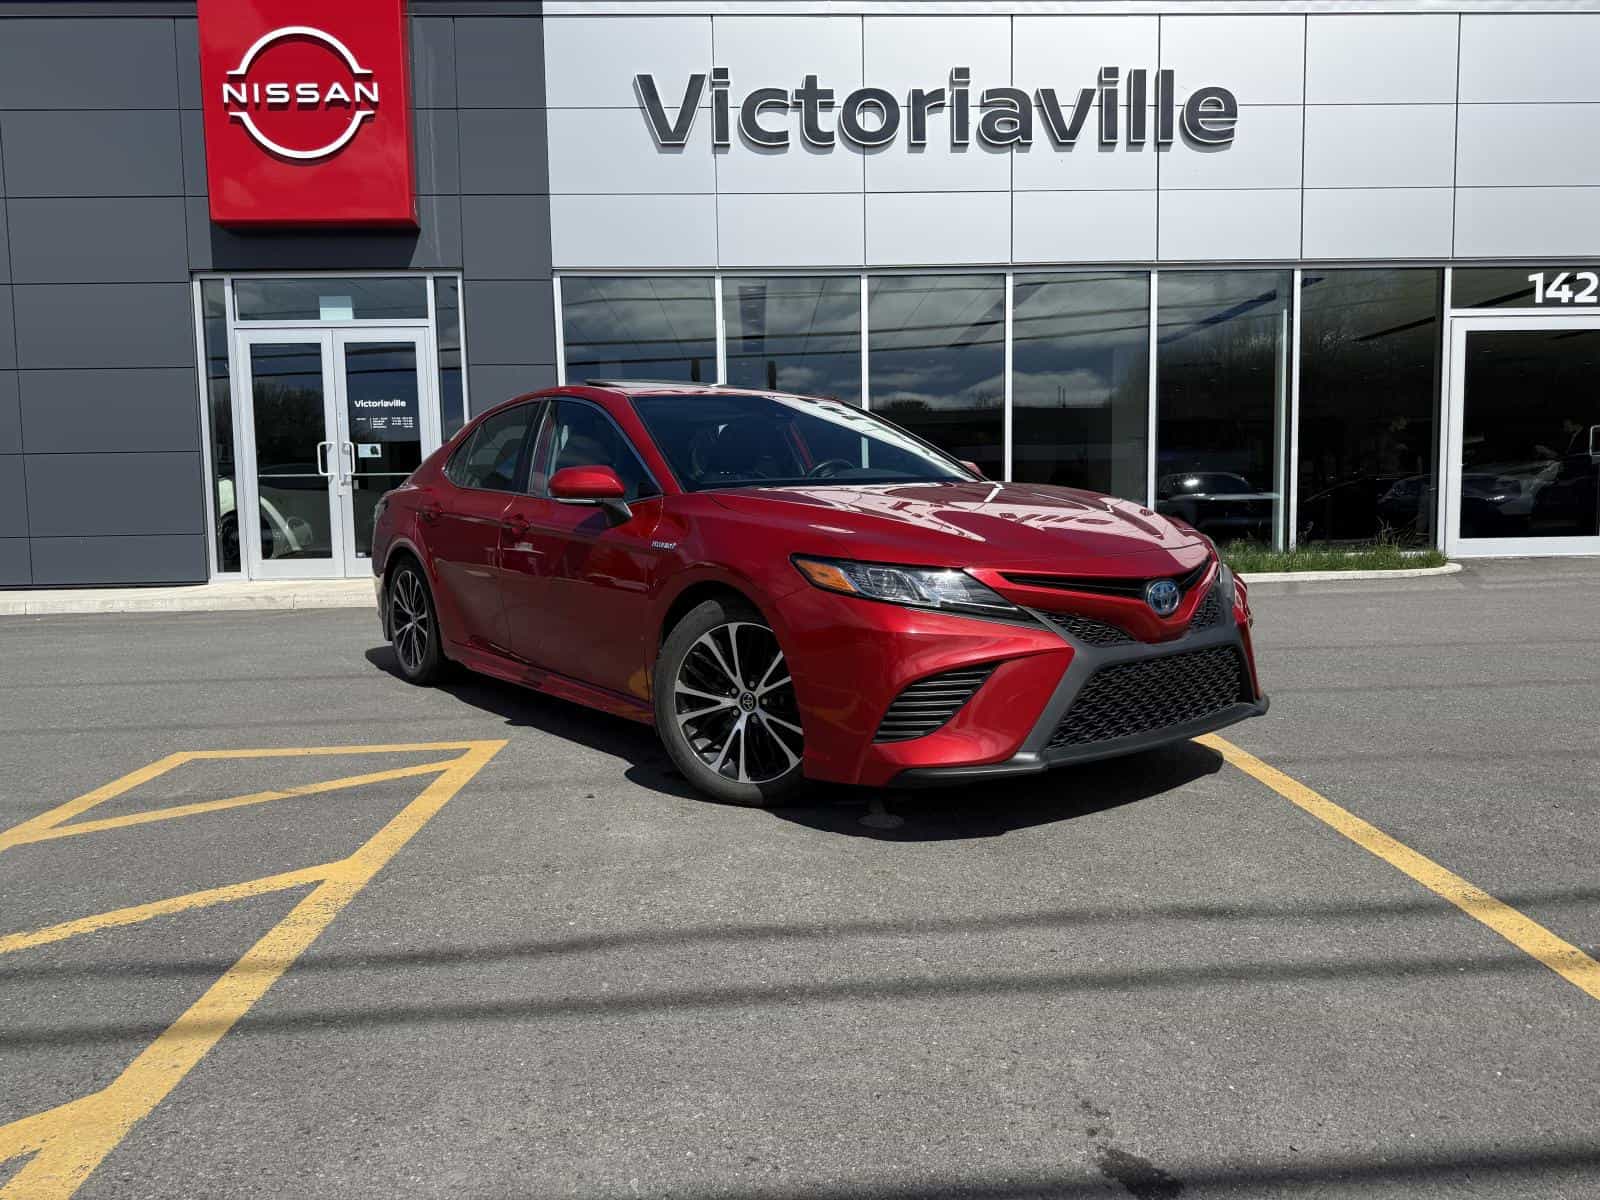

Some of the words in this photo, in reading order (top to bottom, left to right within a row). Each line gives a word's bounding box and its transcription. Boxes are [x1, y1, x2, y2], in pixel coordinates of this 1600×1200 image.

[222, 82, 379, 103] NISSAN
[634, 66, 1238, 150] Victoriaville
[1528, 272, 1598, 303] 142
[354, 399, 406, 408] Victoriaville
